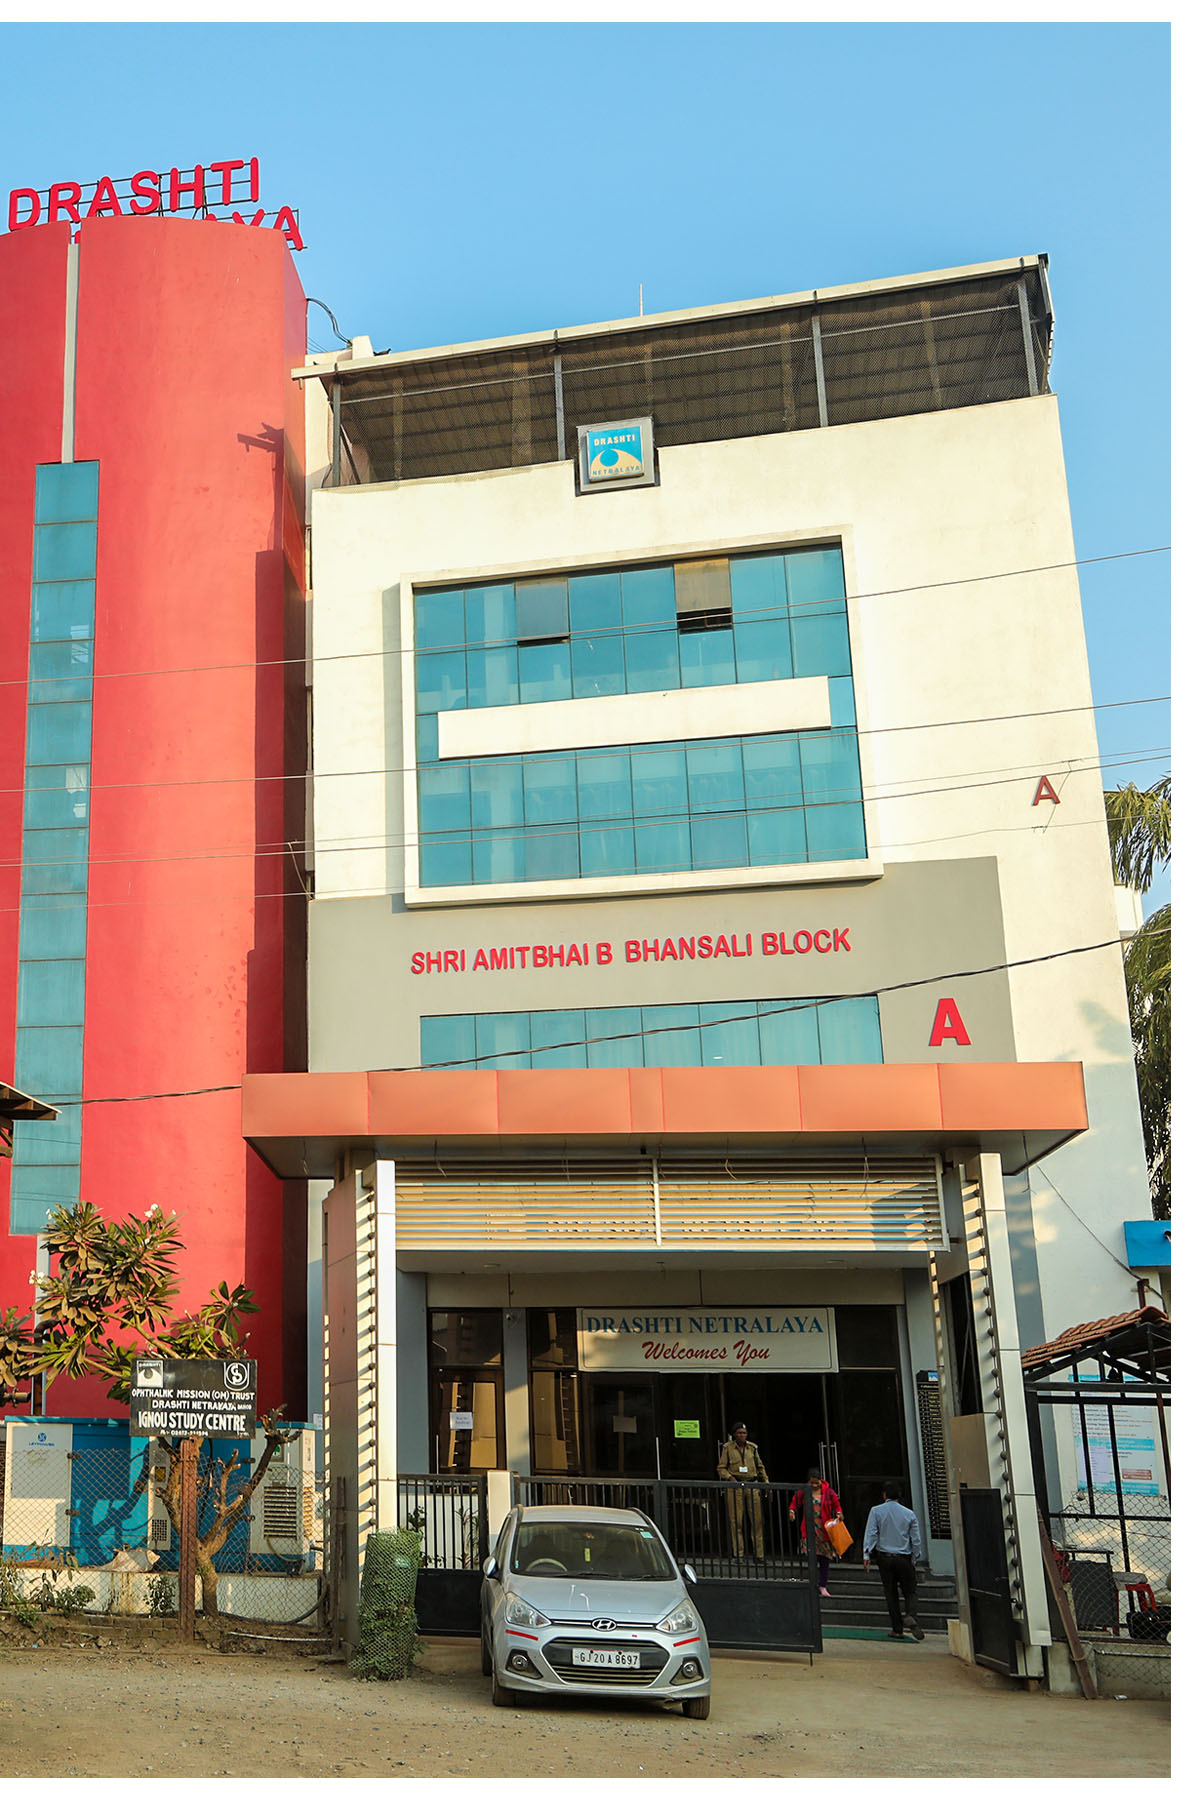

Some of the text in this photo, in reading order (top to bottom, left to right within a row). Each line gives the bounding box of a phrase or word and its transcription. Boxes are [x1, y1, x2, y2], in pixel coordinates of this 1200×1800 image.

[8, 157, 259, 232] DRASHTI
[593, 434, 636, 446] DRASHTI
[592, 465, 640, 475] NETRALAYA
[1031, 775, 1061, 806] A
[410, 948, 466, 975] SHRI
[596, 942, 614, 965] B
[625, 933, 752, 962] BHANSALI
[762, 928, 851, 956] BLOCK
[928, 997, 972, 1046] A
[586, 1316, 824, 1334] DRASHTI NETRALAYA
[641, 1339, 770, 1366] Welcomes You
[152, 1400, 190, 1409] DRASHTI
[176, 1389, 211, 1400] MISSION
[230, 1391, 255, 1401] TRUST
[138, 1411, 246, 1431] IGNOU STUDY CENTRE
[593, 1653, 605, 1664] 20
[615, 1655, 638, 1665] 8697
